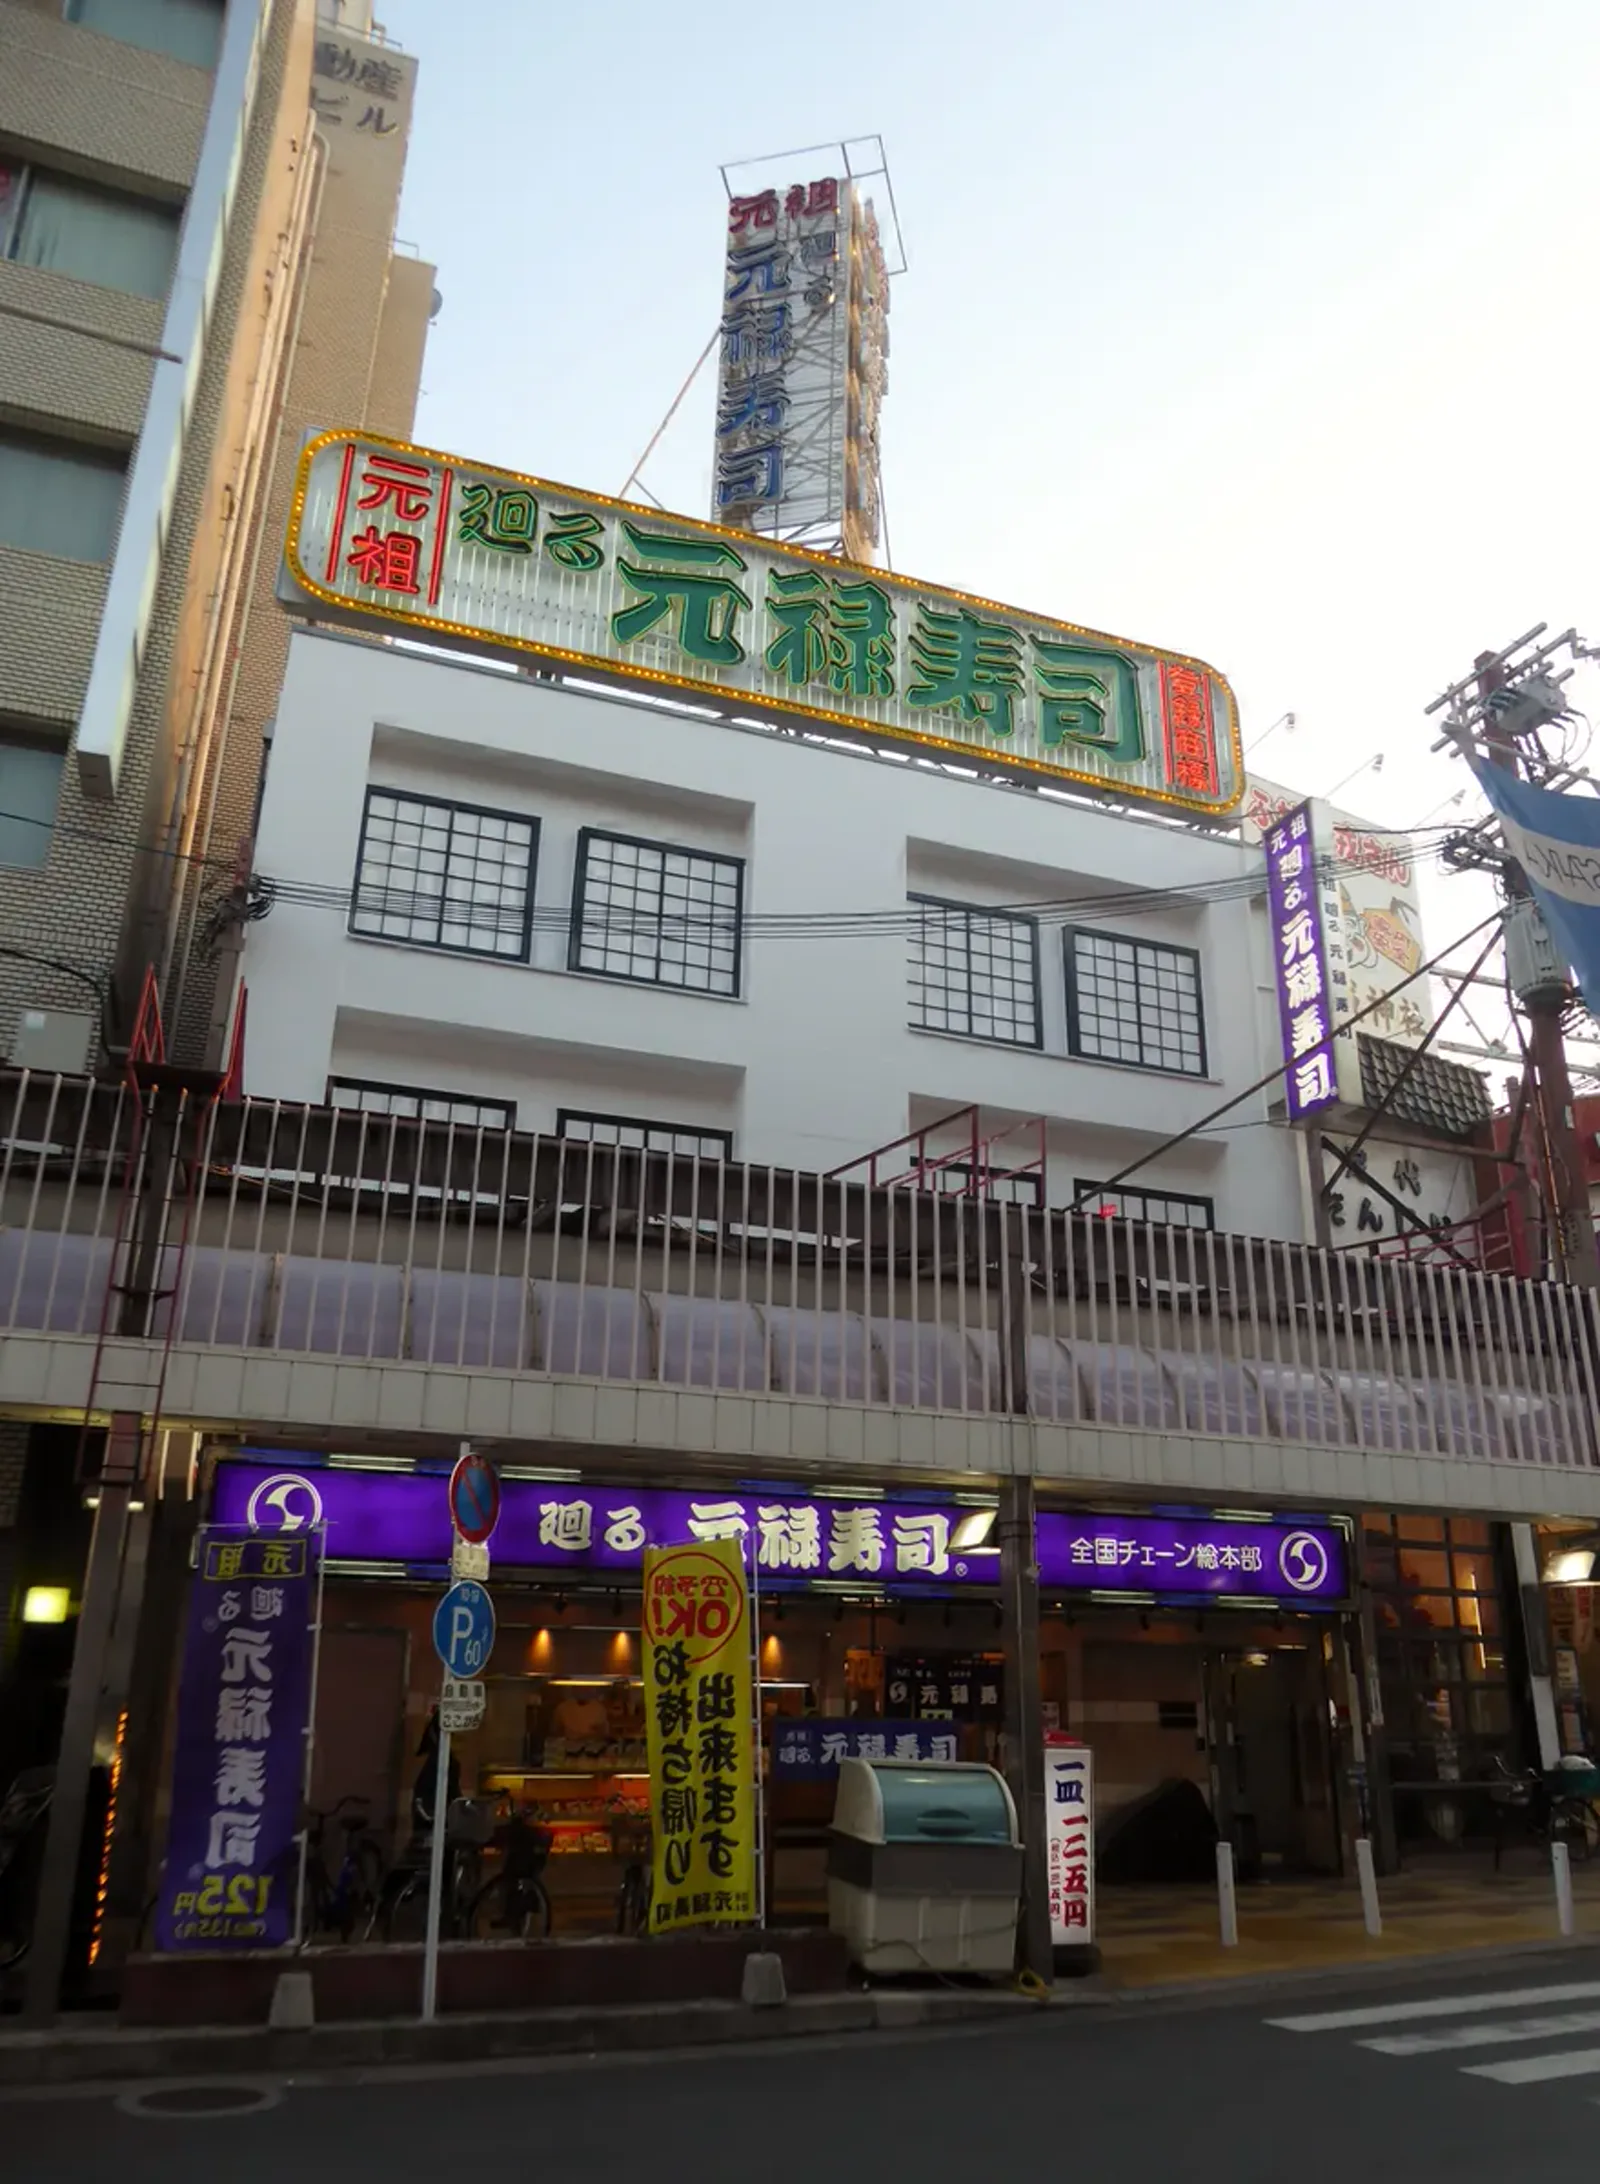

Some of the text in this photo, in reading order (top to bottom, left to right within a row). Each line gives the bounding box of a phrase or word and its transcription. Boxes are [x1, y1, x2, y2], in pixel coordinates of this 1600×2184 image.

[729, 177, 839, 234] 元祖
[347, 454, 432, 596] 元祖
[1271, 813, 1309, 856] 元祖
[1069, 1537, 1263, 1572] 全国チェーン総本部
[450, 1606, 474, 1665] P
[1053, 1761, 1086, 1804] 一皿
[1061, 1815, 1089, 1929] 一二五円
